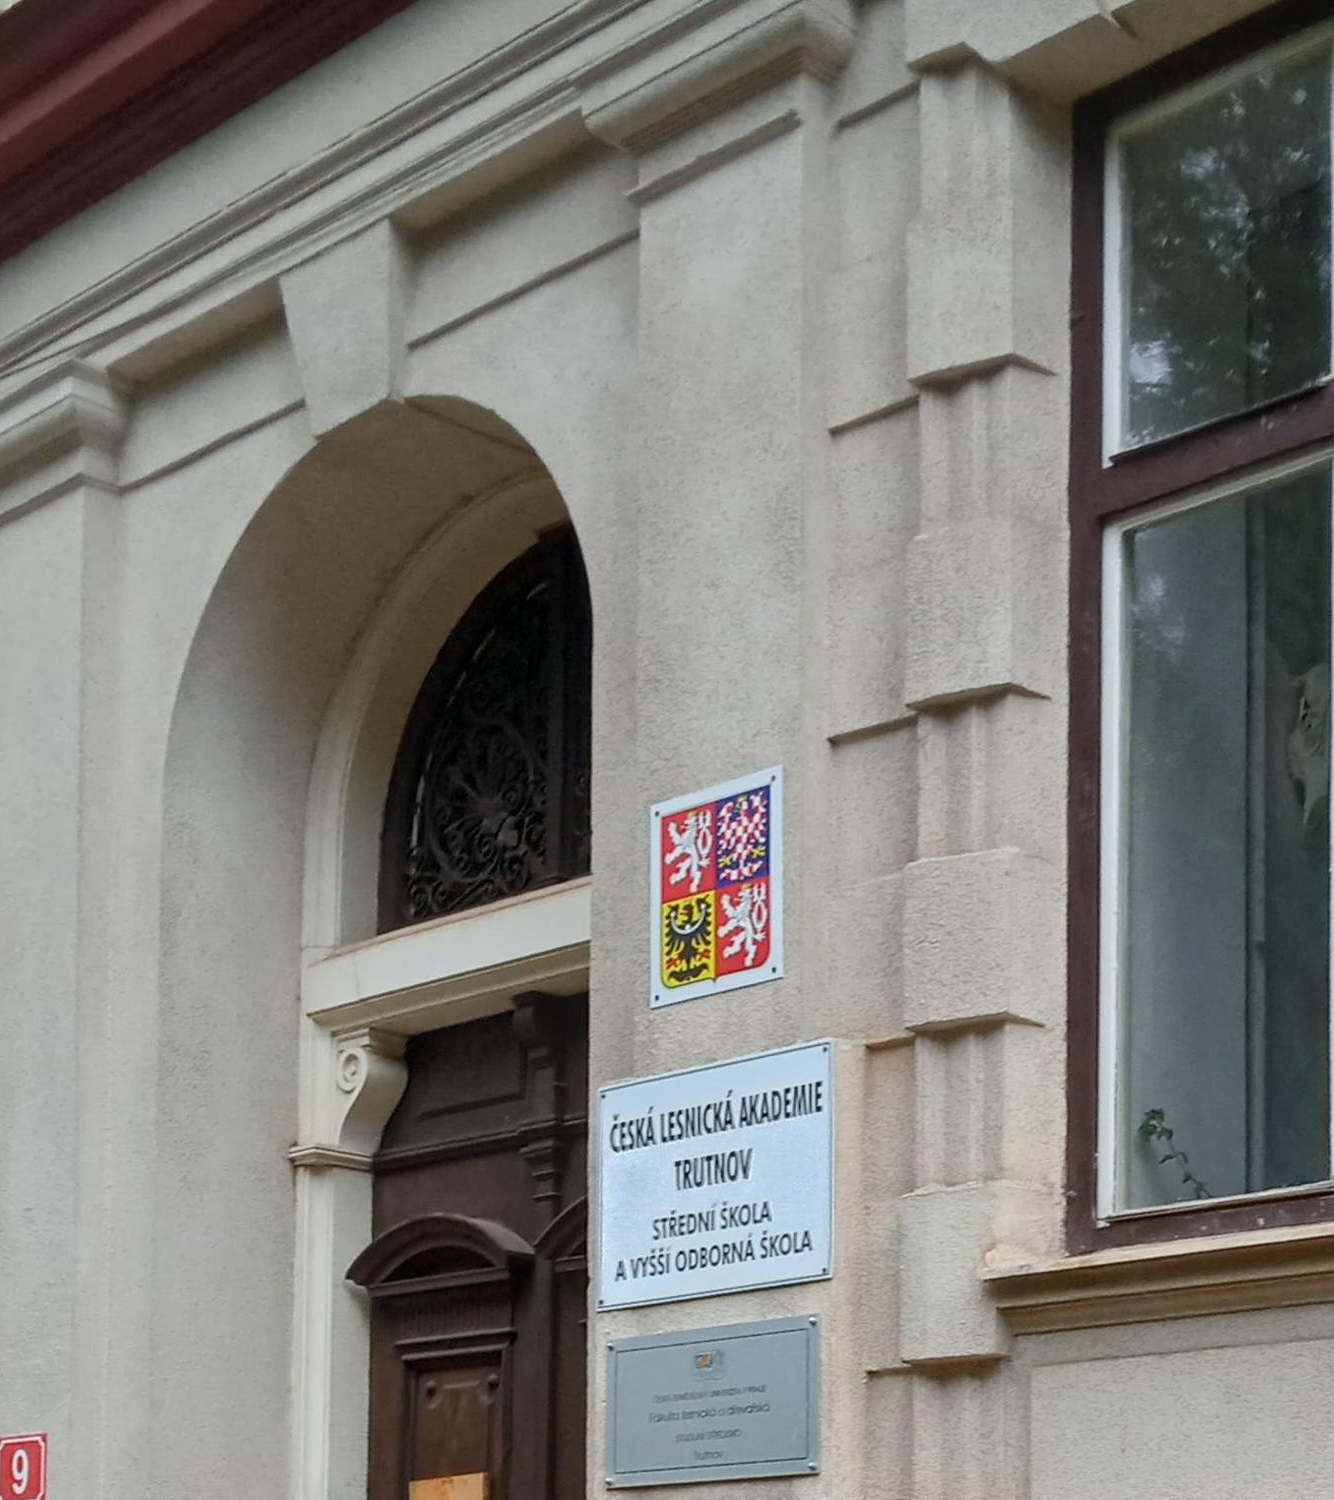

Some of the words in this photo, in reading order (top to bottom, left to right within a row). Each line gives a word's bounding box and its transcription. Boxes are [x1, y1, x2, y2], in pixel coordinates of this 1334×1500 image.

[610, 1105, 656, 1153] ČESKÁ
[660, 1089, 736, 1143] LESNICKÁ
[739, 1081, 823, 1128] AKADEMIE
[674, 1148, 753, 1190] TRUTNOV
[652, 1203, 716, 1240] STŘEDNÍ
[720, 1201, 772, 1229] ŠKOLA
[614, 1260, 627, 1281] A
[630, 1246, 671, 1279] VYŠŠÍ
[675, 1233, 755, 1272] ODBORNÁ
[760, 1230, 813, 1259] ŠKOLA
[12, 1449, 29, 1494] 9
